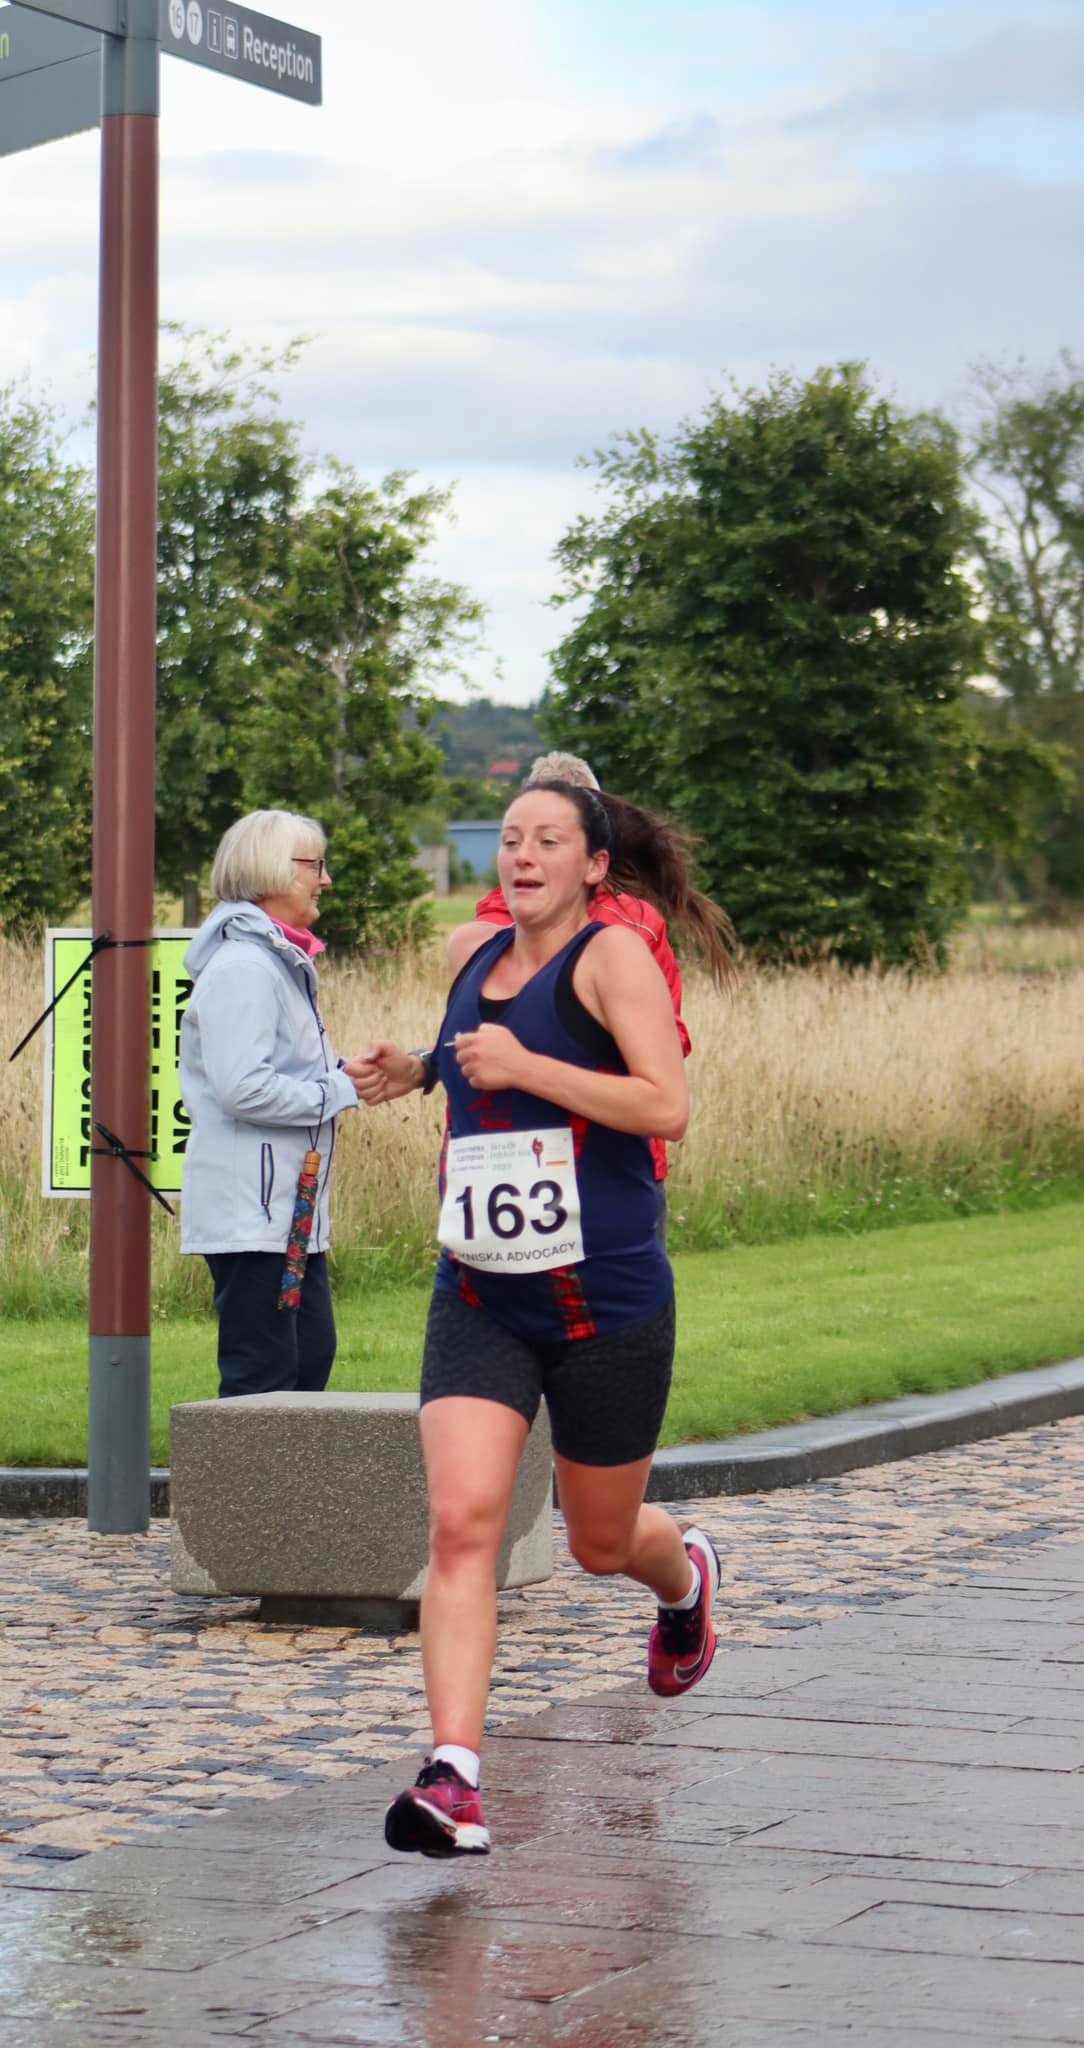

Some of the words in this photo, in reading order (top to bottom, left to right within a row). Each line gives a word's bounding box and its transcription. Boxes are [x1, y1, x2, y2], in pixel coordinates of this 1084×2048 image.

[243, 25, 314, 84] Reception
[455, 1179, 569, 1241] 163
[460, 1251, 503, 1262] YNISKA
[506, 1241, 577, 1262] ADVOCACY
